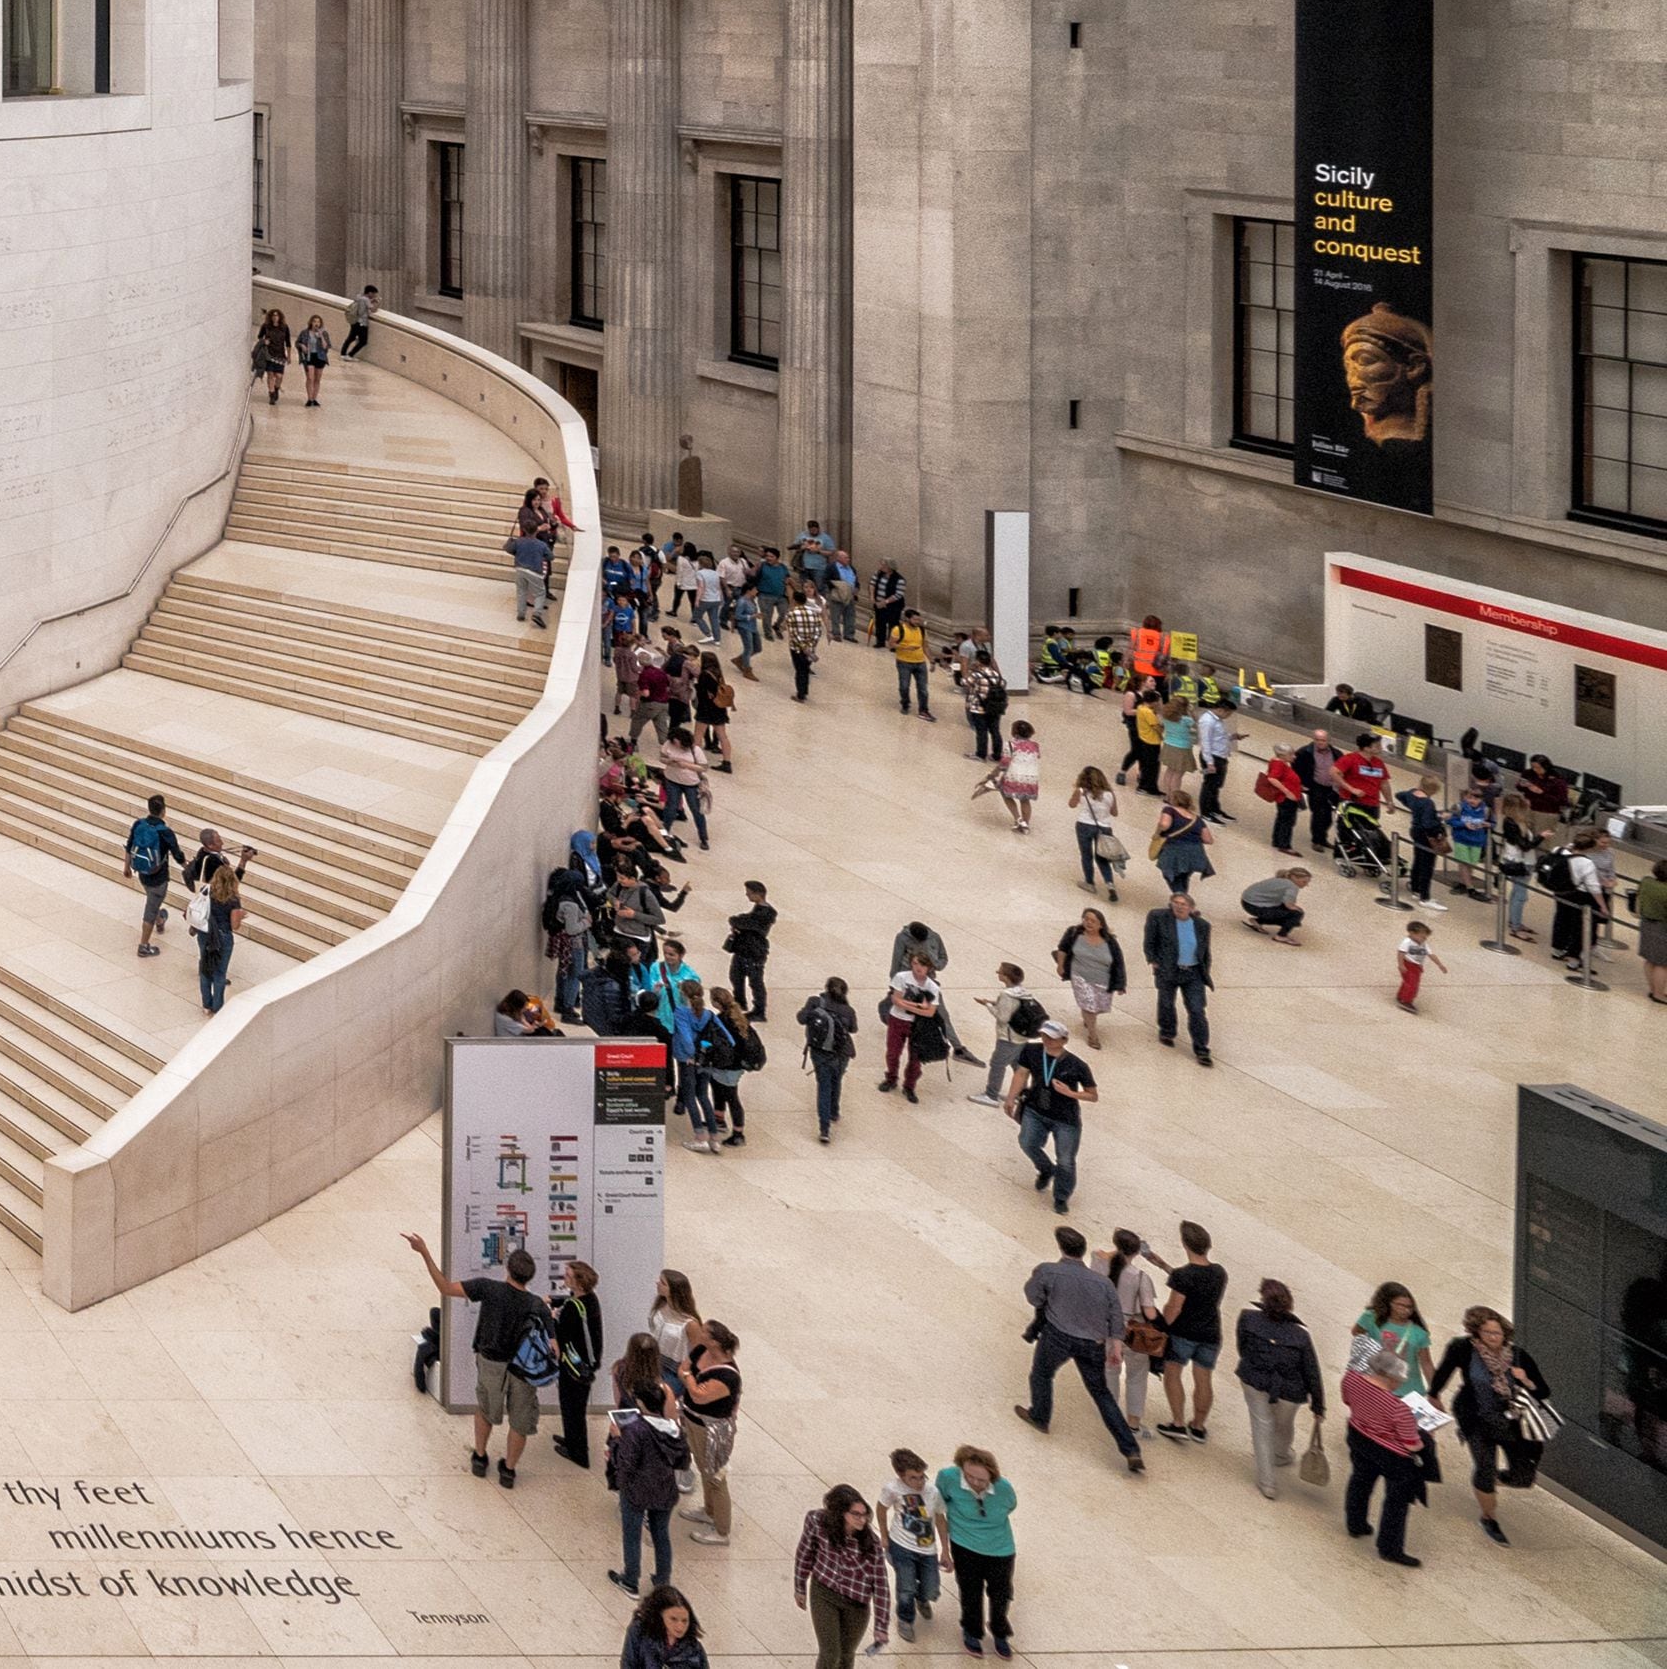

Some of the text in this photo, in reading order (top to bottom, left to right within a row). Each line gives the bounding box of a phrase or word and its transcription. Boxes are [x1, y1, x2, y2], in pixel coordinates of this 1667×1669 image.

[1314, 163, 1375, 190] Sicily
[1314, 190, 1393, 213] culture
[1314, 215, 1356, 233] and
[1314, 239, 1421, 265] conquest
[1479, 605, 1558, 636] Membership
[2, 1479, 66, 1513] thy
[73, 1479, 155, 1507] feet
[47, 1522, 404, 1552] millenniums hence
[99, 1566, 142, 1599] of
[149, 1567, 362, 1606] knowledge
[406, 1608, 492, 1628] Tennyson
